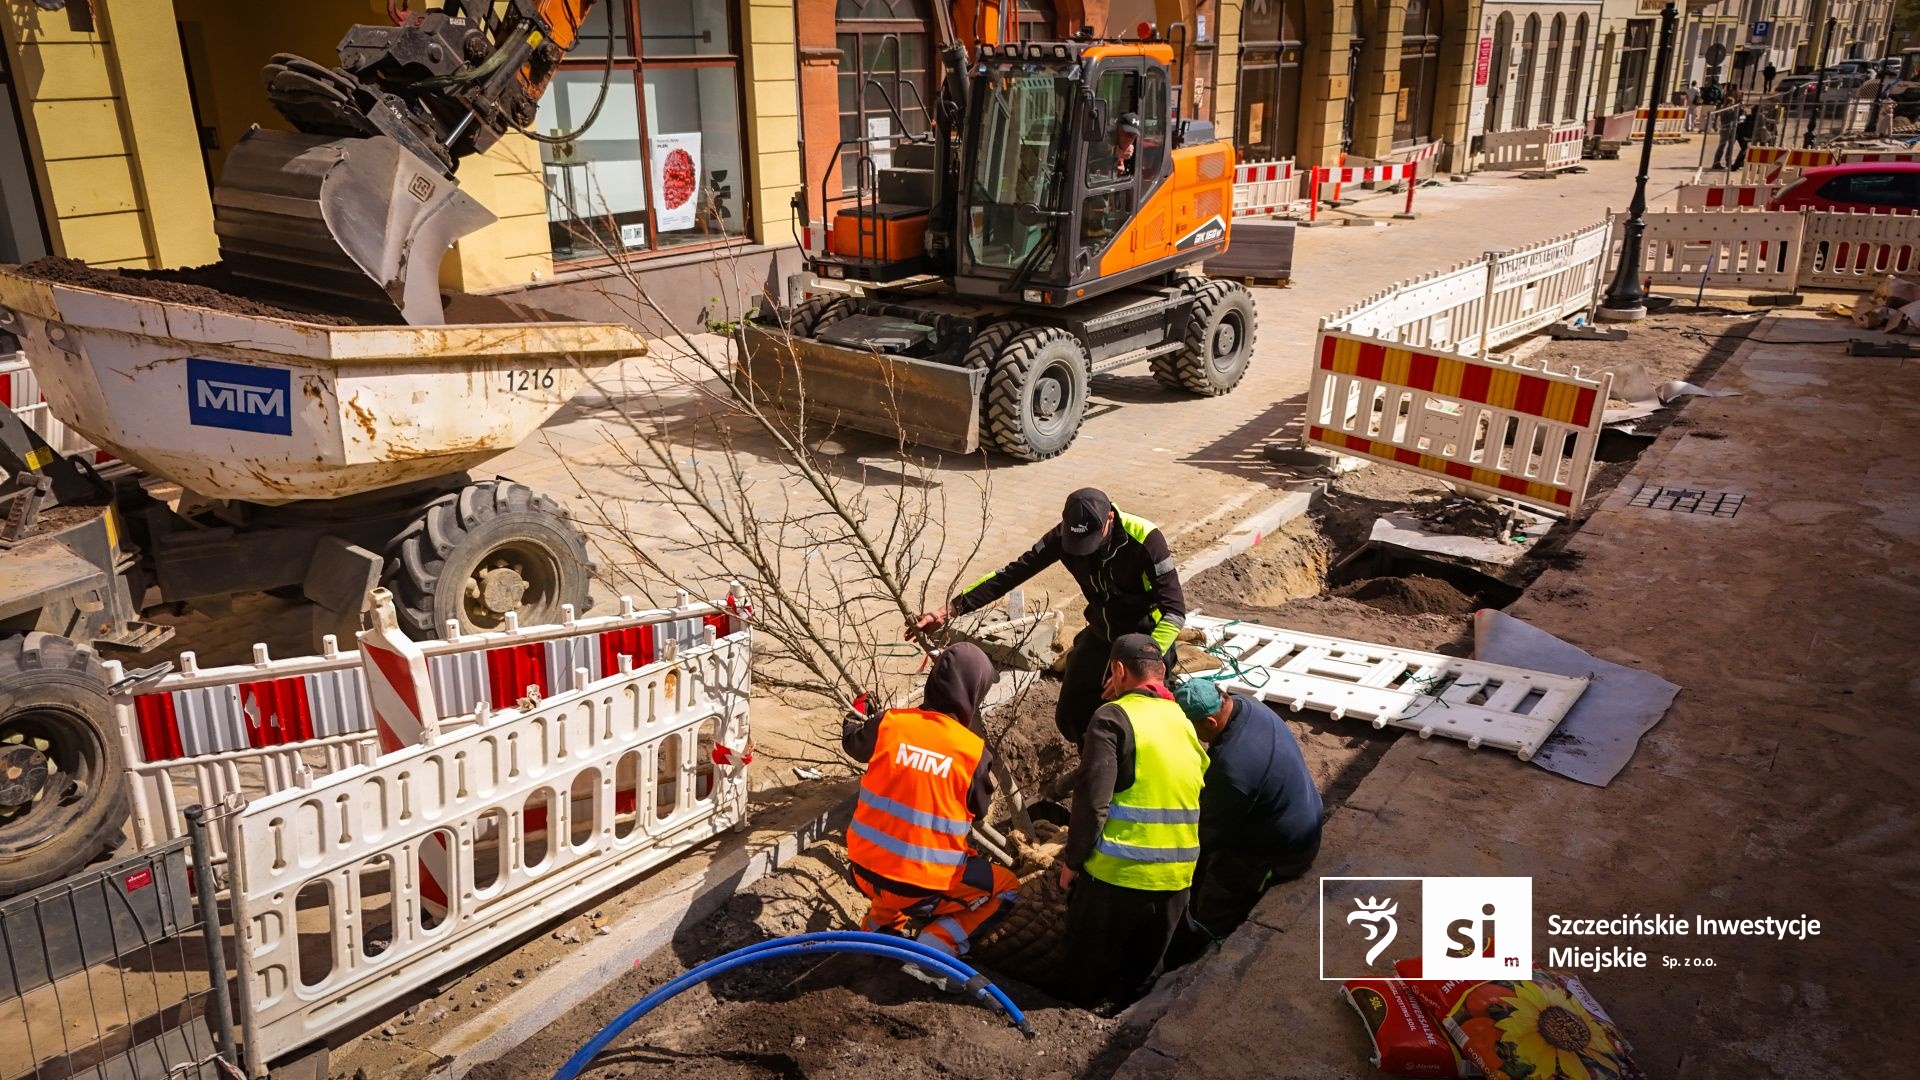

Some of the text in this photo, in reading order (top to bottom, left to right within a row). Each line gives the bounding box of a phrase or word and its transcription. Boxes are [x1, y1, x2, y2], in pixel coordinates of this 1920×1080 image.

[1756, 22, 1767, 33] P
[507, 368, 554, 391] 1216
[196, 379, 285, 418] MTM
[896, 743, 953, 779] MTM
